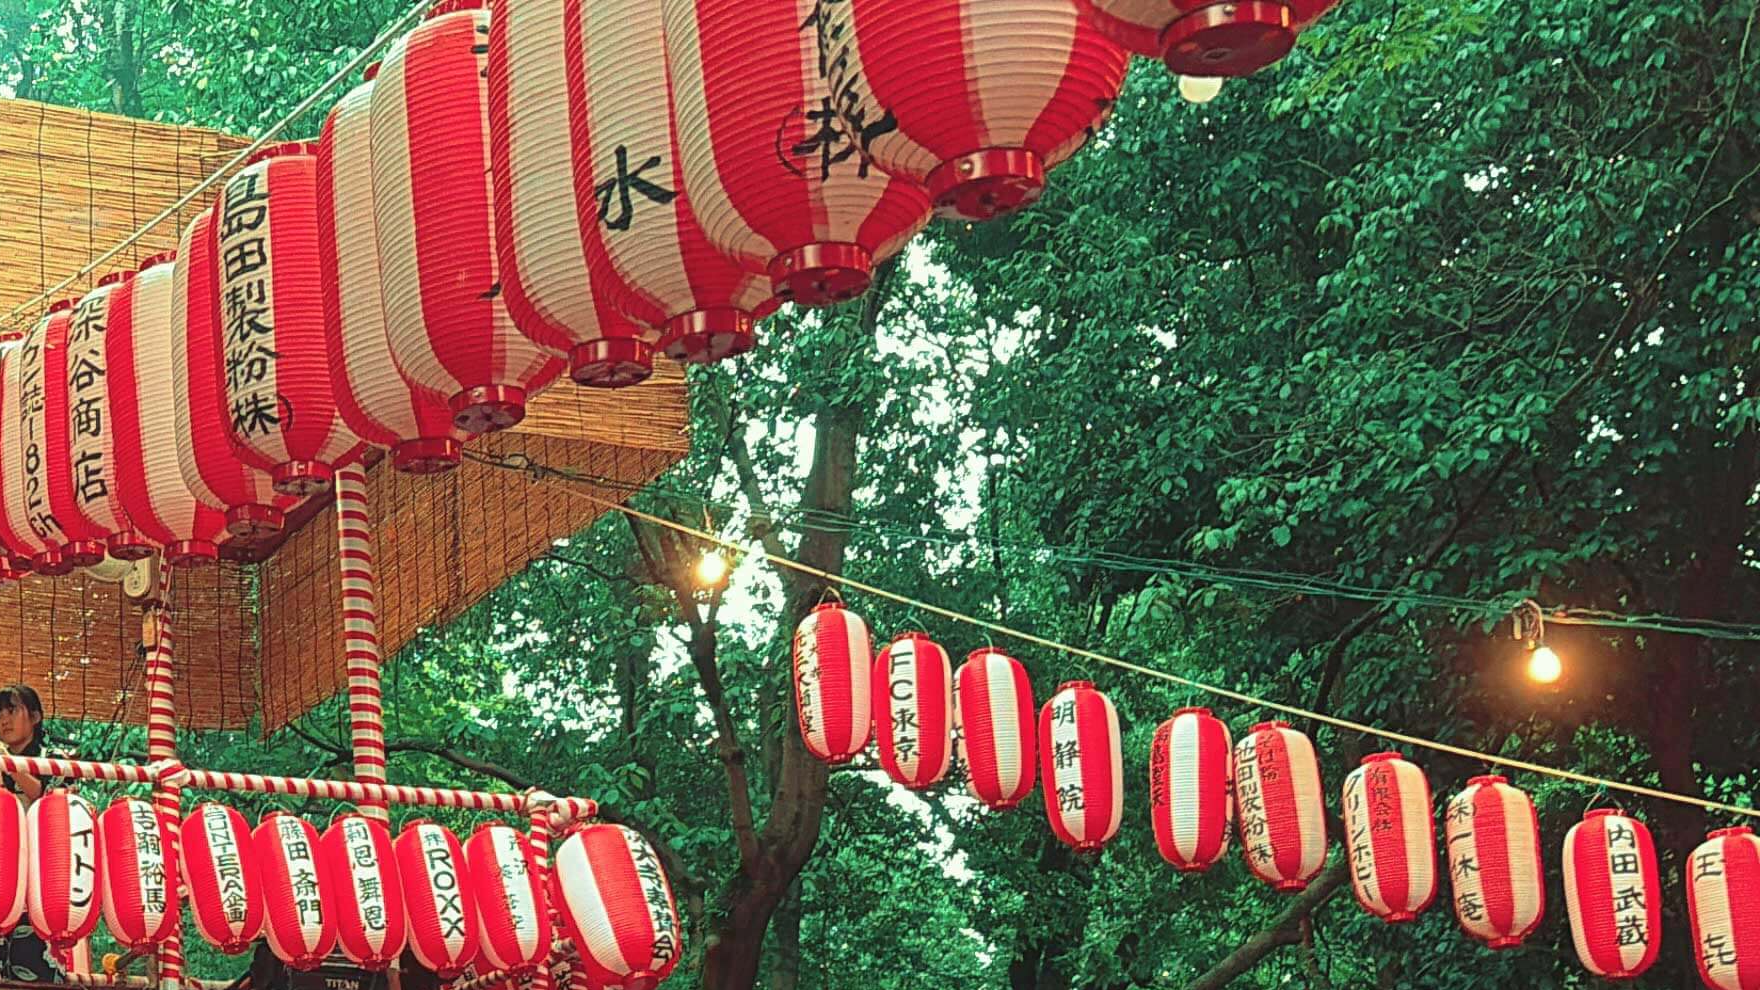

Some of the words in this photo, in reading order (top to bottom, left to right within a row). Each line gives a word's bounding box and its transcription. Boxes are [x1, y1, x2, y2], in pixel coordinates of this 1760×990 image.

[890, 651, 921, 763] FC東京
[1051, 699, 1086, 813] 明静院
[1607, 823, 1649, 946] 内田武蔵
